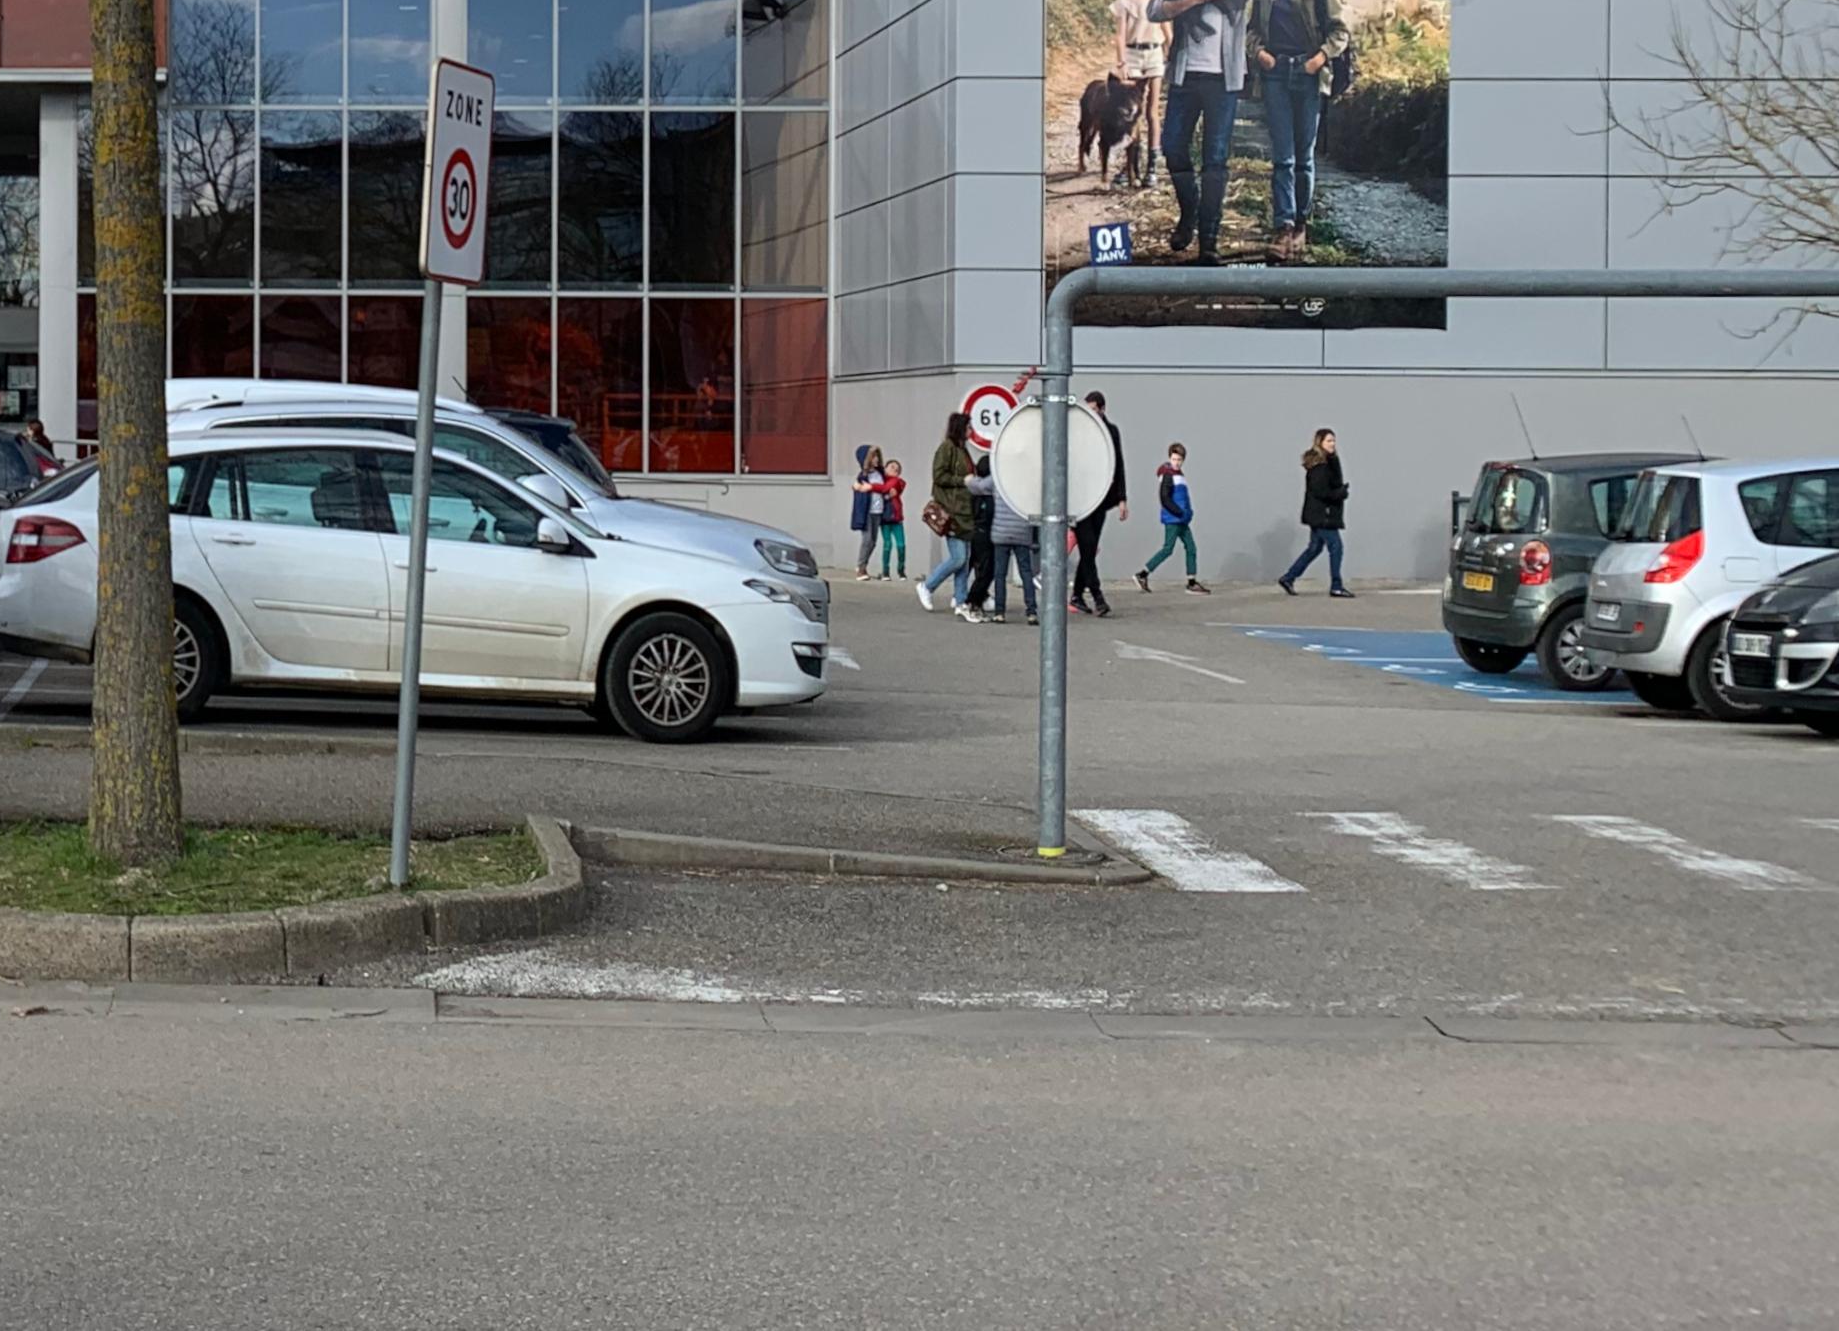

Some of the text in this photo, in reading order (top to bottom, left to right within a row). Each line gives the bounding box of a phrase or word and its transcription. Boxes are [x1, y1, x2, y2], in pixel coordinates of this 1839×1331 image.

[445, 89, 483, 126] ZONE
[447, 176, 470, 221] 30
[1096, 226, 1123, 251] 01
[1095, 249, 1128, 263] JANV.
